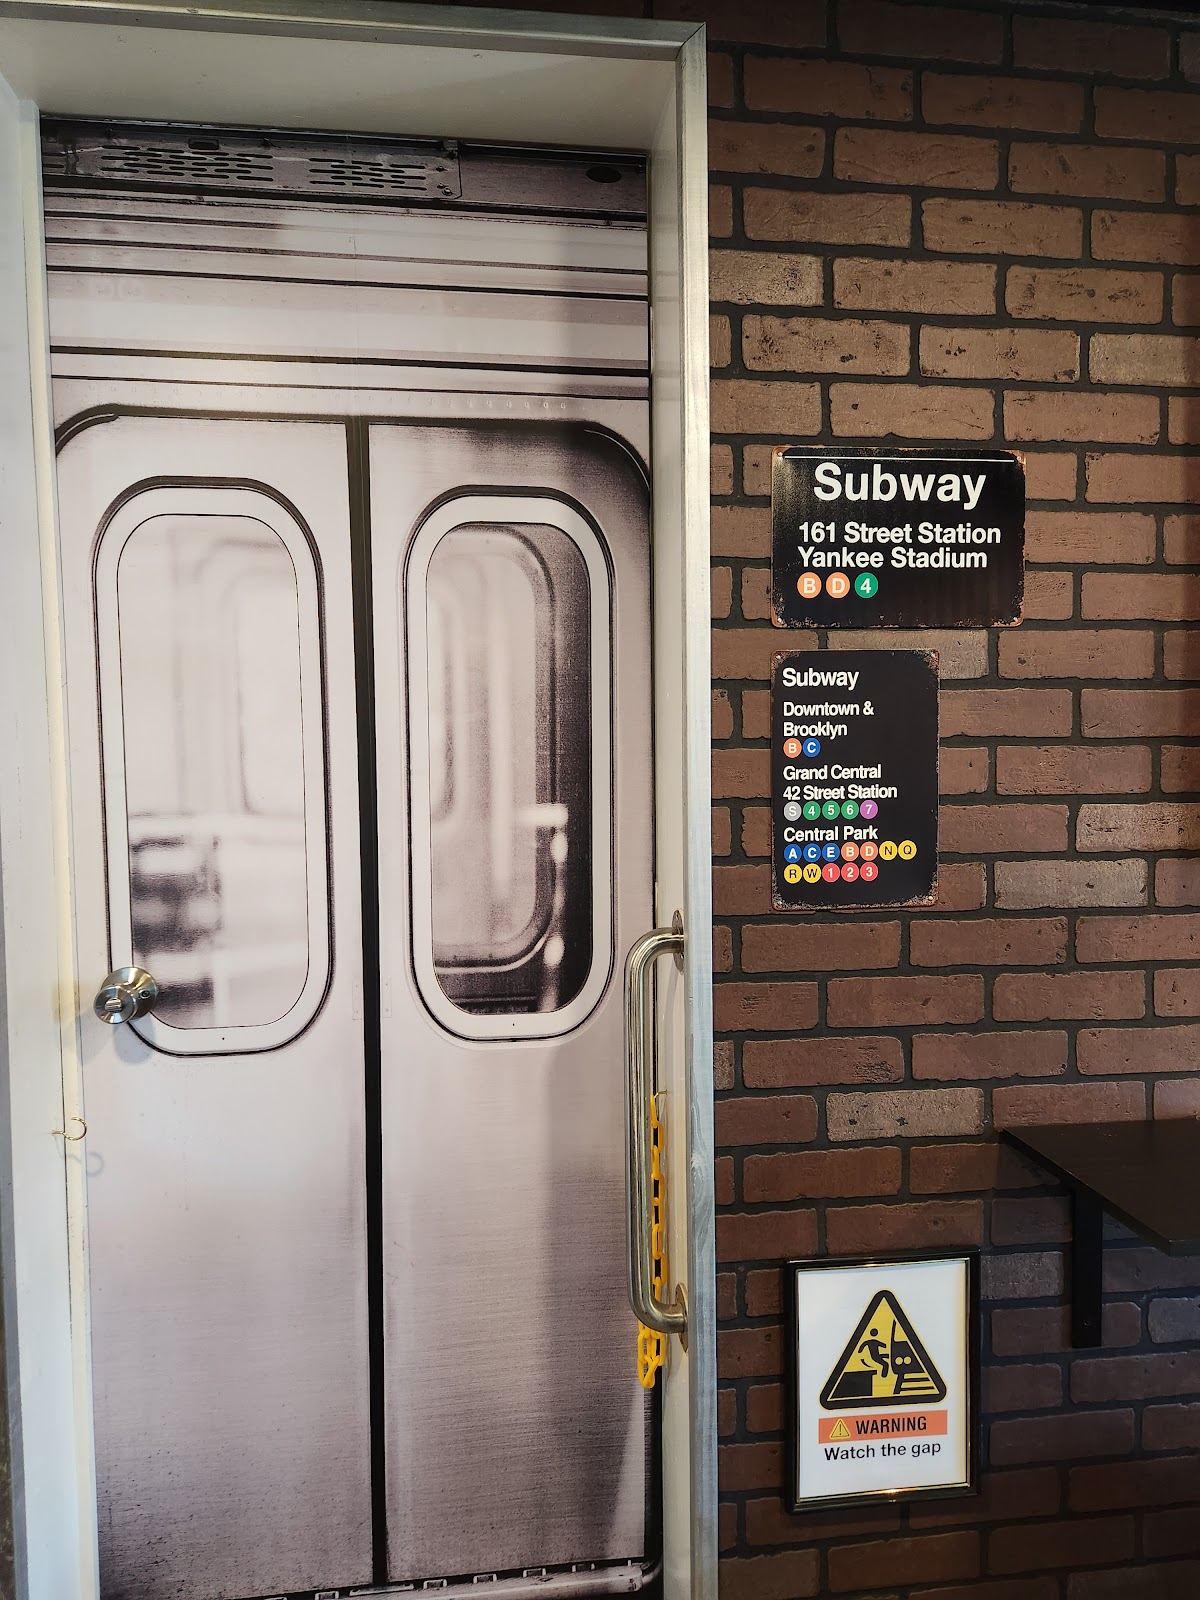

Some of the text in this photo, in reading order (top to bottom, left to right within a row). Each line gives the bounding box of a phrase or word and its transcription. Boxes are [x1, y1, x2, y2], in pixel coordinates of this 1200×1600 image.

[814, 462, 986, 510] Subway
[799, 522, 1001, 543] 161 Street Station
[798, 546, 987, 568] Yankee Stadium
[803, 578, 871, 594] B D 4
[783, 668, 859, 690] Subway
[783, 701, 874, 716] Downtown &
[783, 722, 847, 739] Brooklyn
[788, 742, 816, 753] B C
[783, 764, 881, 780] Grand Central
[783, 784, 897, 800] 42 Street Station
[789, 805, 872, 816] S 4 5 6 7
[784, 825, 878, 842] Central Park
[788, 845, 912, 859] A C E B D N Q
[789, 867, 873, 878] R W 1 2 3
[856, 1416, 927, 1434] WARNING
[824, 1443, 941, 1461] Watch the gap
